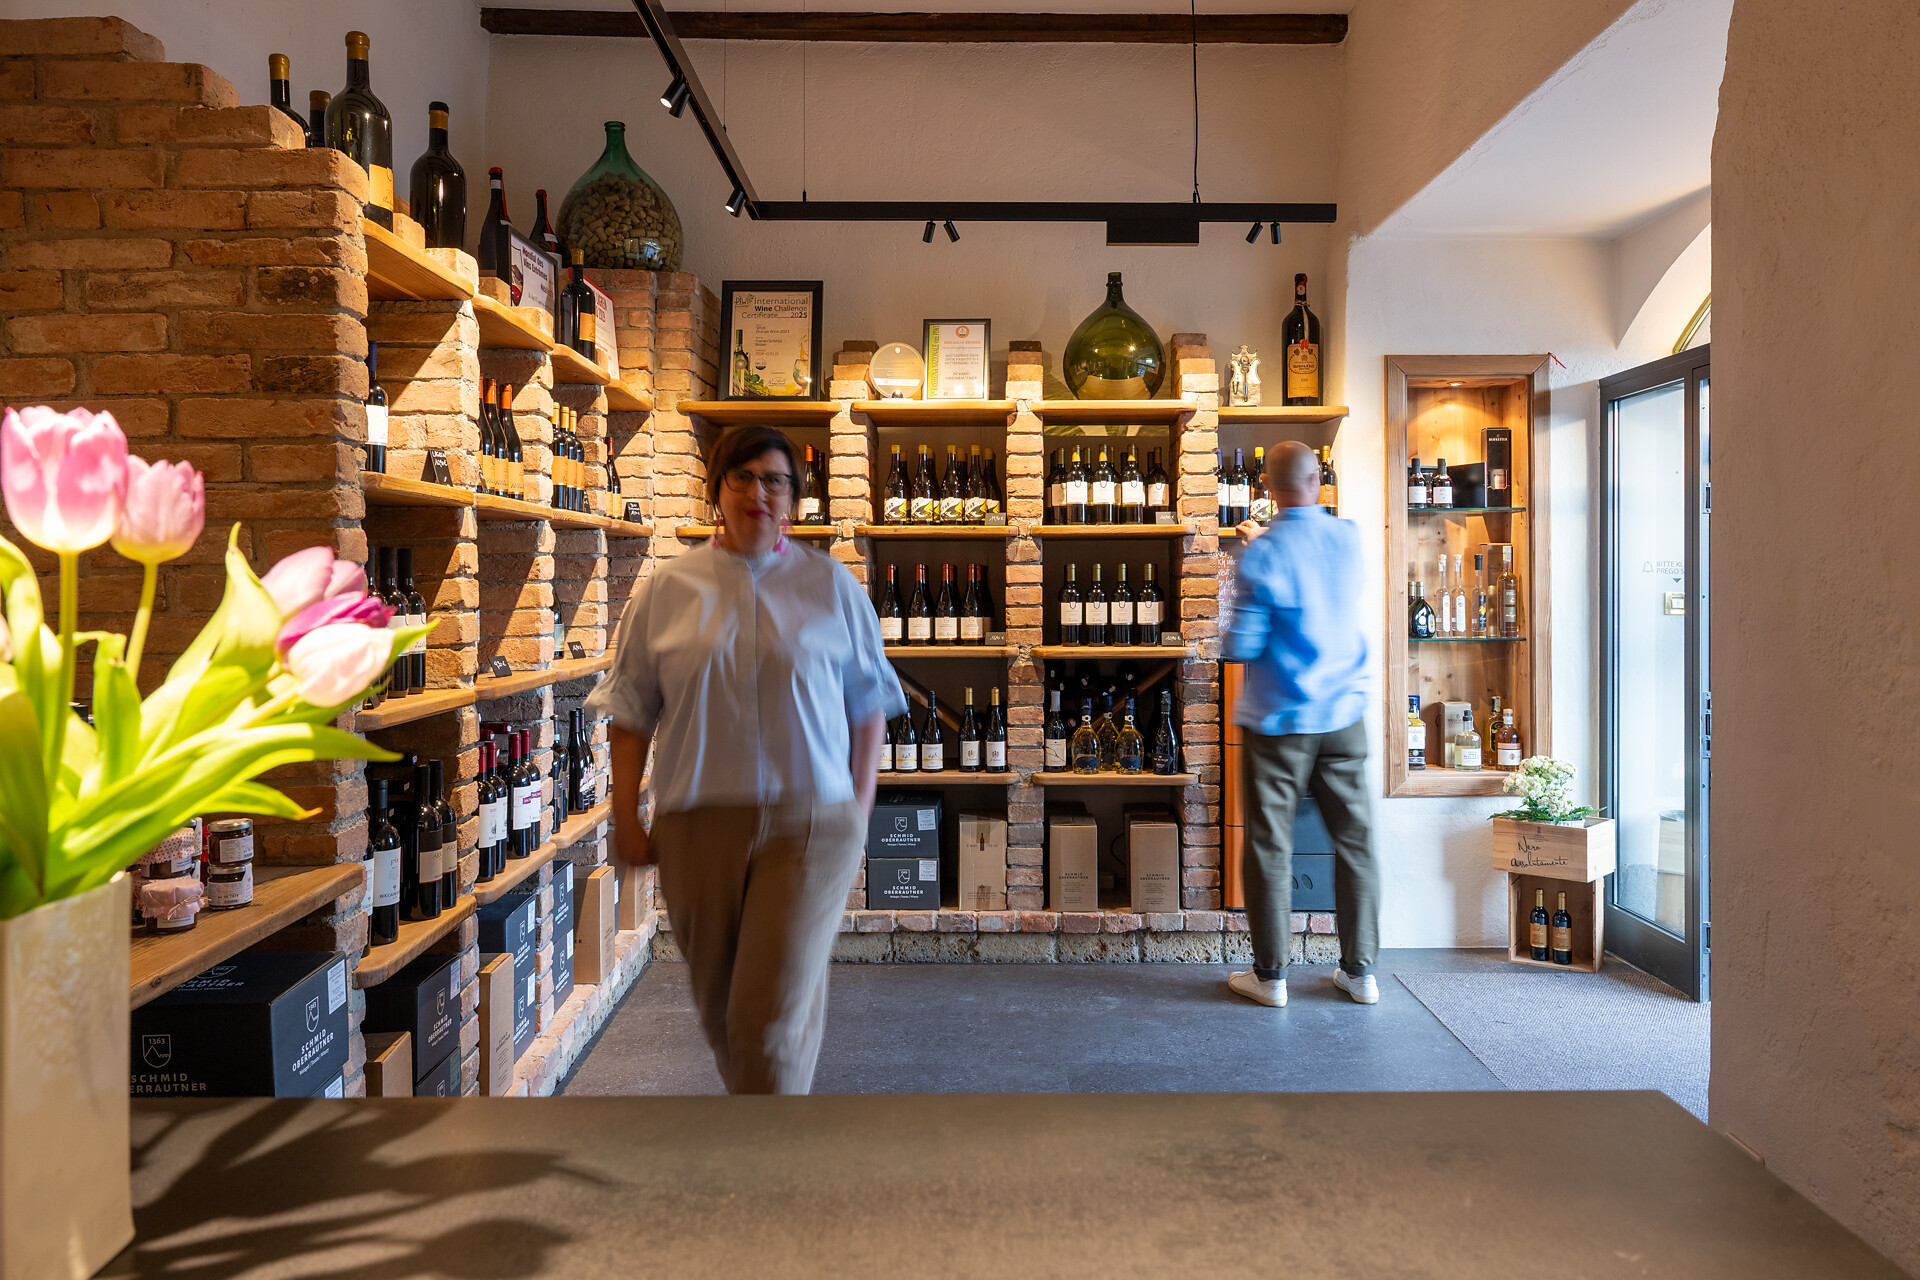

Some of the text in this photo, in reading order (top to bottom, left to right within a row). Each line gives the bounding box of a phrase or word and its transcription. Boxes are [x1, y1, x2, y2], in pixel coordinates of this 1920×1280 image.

[1518, 836, 1541, 853] Nero
[301, 1029, 326, 1055] SCHMID
[292, 1032, 334, 1072] OBERRAUTNER
[130, 1073, 188, 1083] SCHMID
[130, 1082, 207, 1093] ERRAUTNER
